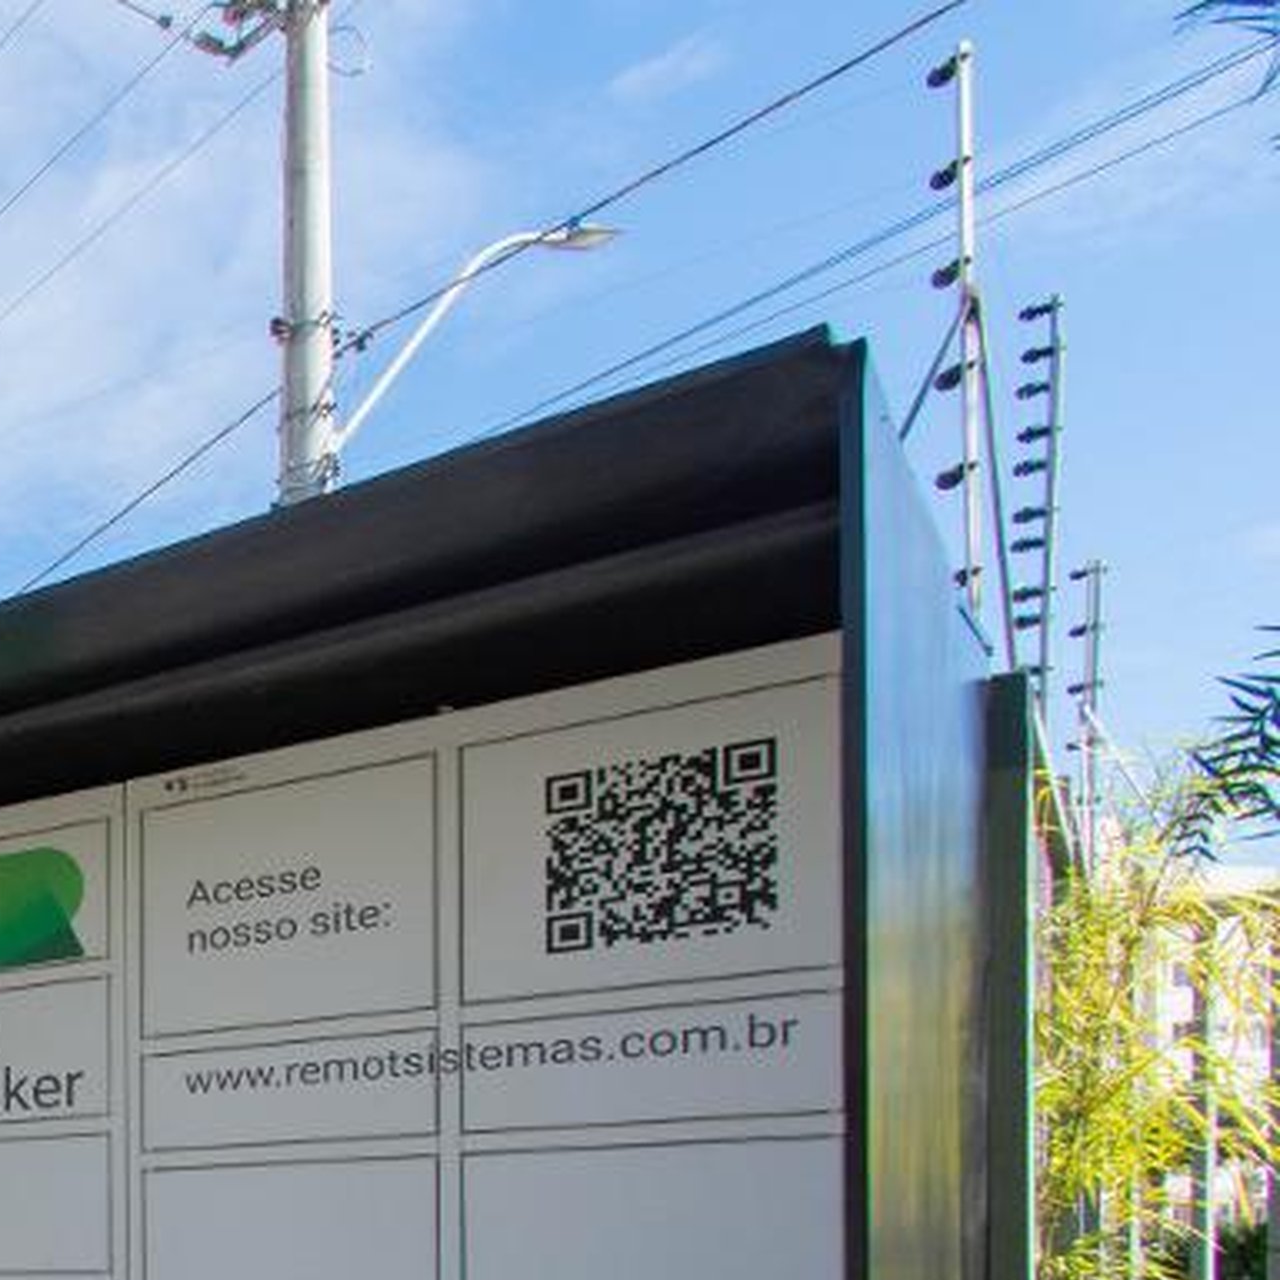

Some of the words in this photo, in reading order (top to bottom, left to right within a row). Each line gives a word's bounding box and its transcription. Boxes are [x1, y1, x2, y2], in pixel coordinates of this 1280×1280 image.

[187, 866, 322, 908] Acesse
[188, 917, 298, 954] nosso
[309, 902, 392, 936] site:
[184, 1013, 799, 1096] www.remotsistemas.com.br
